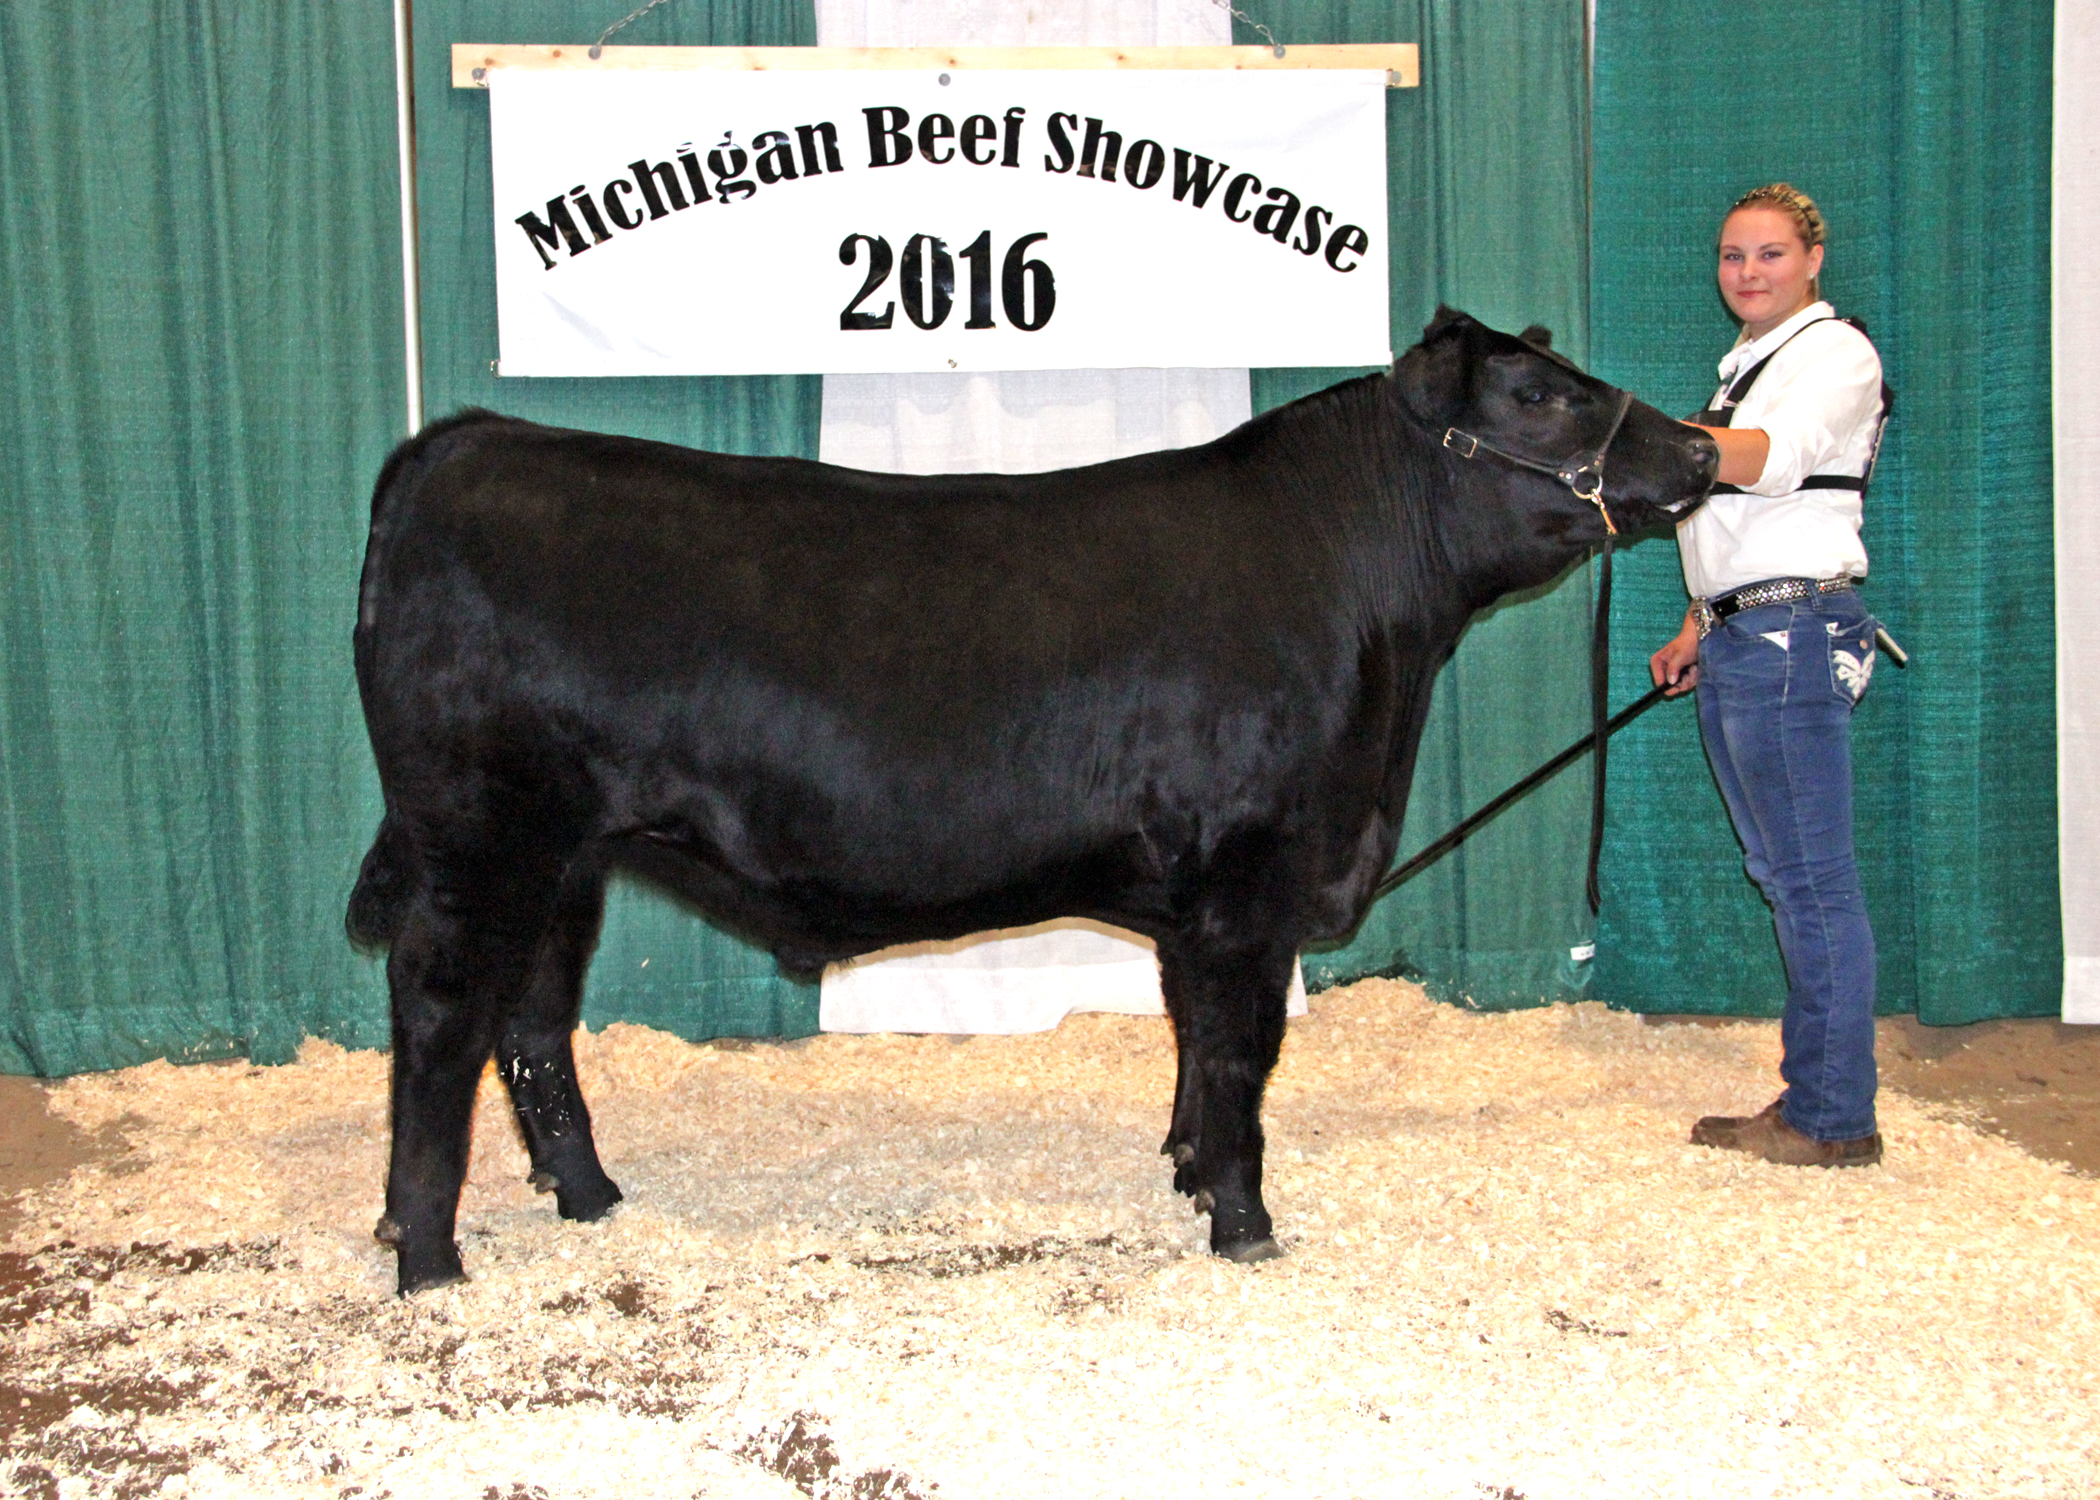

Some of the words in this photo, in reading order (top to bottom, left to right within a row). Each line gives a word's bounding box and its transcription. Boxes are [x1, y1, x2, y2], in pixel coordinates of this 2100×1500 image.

[514, 121, 845, 271] Michigan
[861, 106, 1026, 168] Beef
[1044, 112, 1369, 273] Showcase
[838, 230, 1056, 332] 2016
